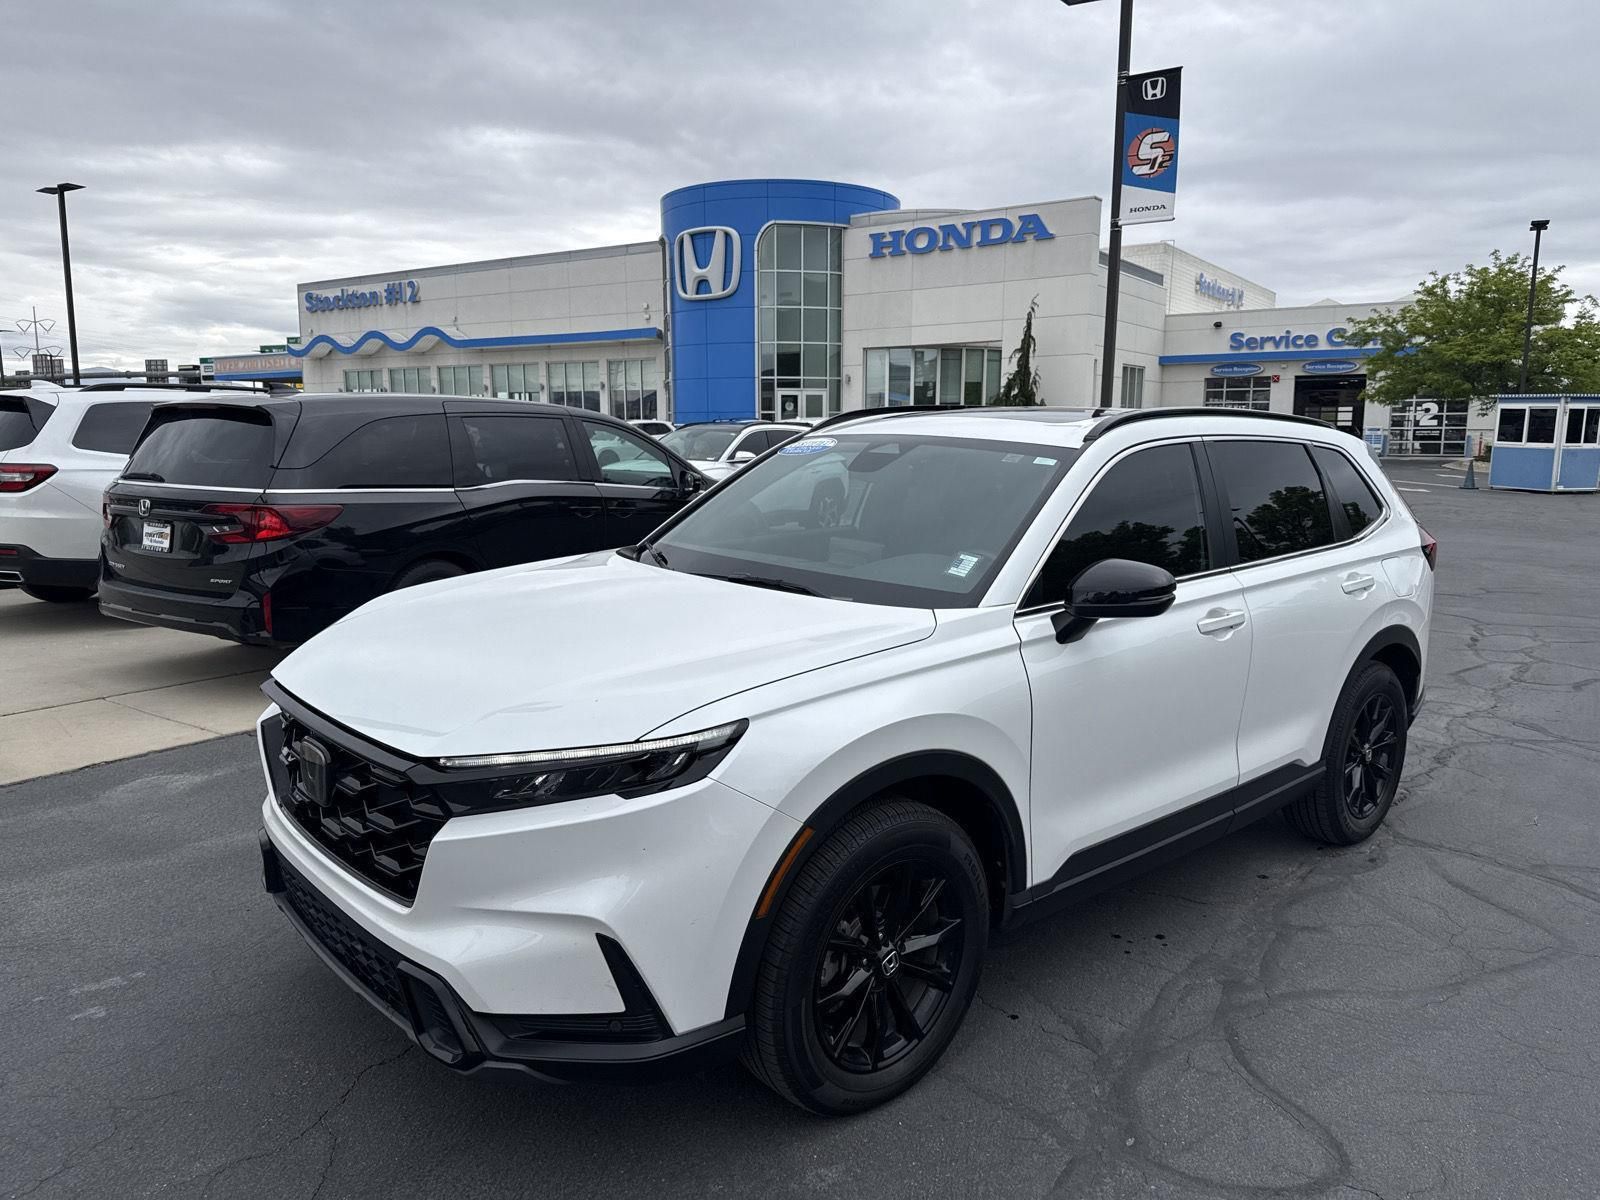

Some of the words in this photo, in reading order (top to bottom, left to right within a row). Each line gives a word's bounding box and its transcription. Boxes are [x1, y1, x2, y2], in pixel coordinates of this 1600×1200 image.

[1129, 204, 1167, 213] HONDA
[868, 213, 1056, 258] HONDA
[305, 288, 382, 313] Stockton
[384, 280, 420, 306] #12
[1229, 330, 1319, 351] Service
[1419, 402, 1439, 426] 2
